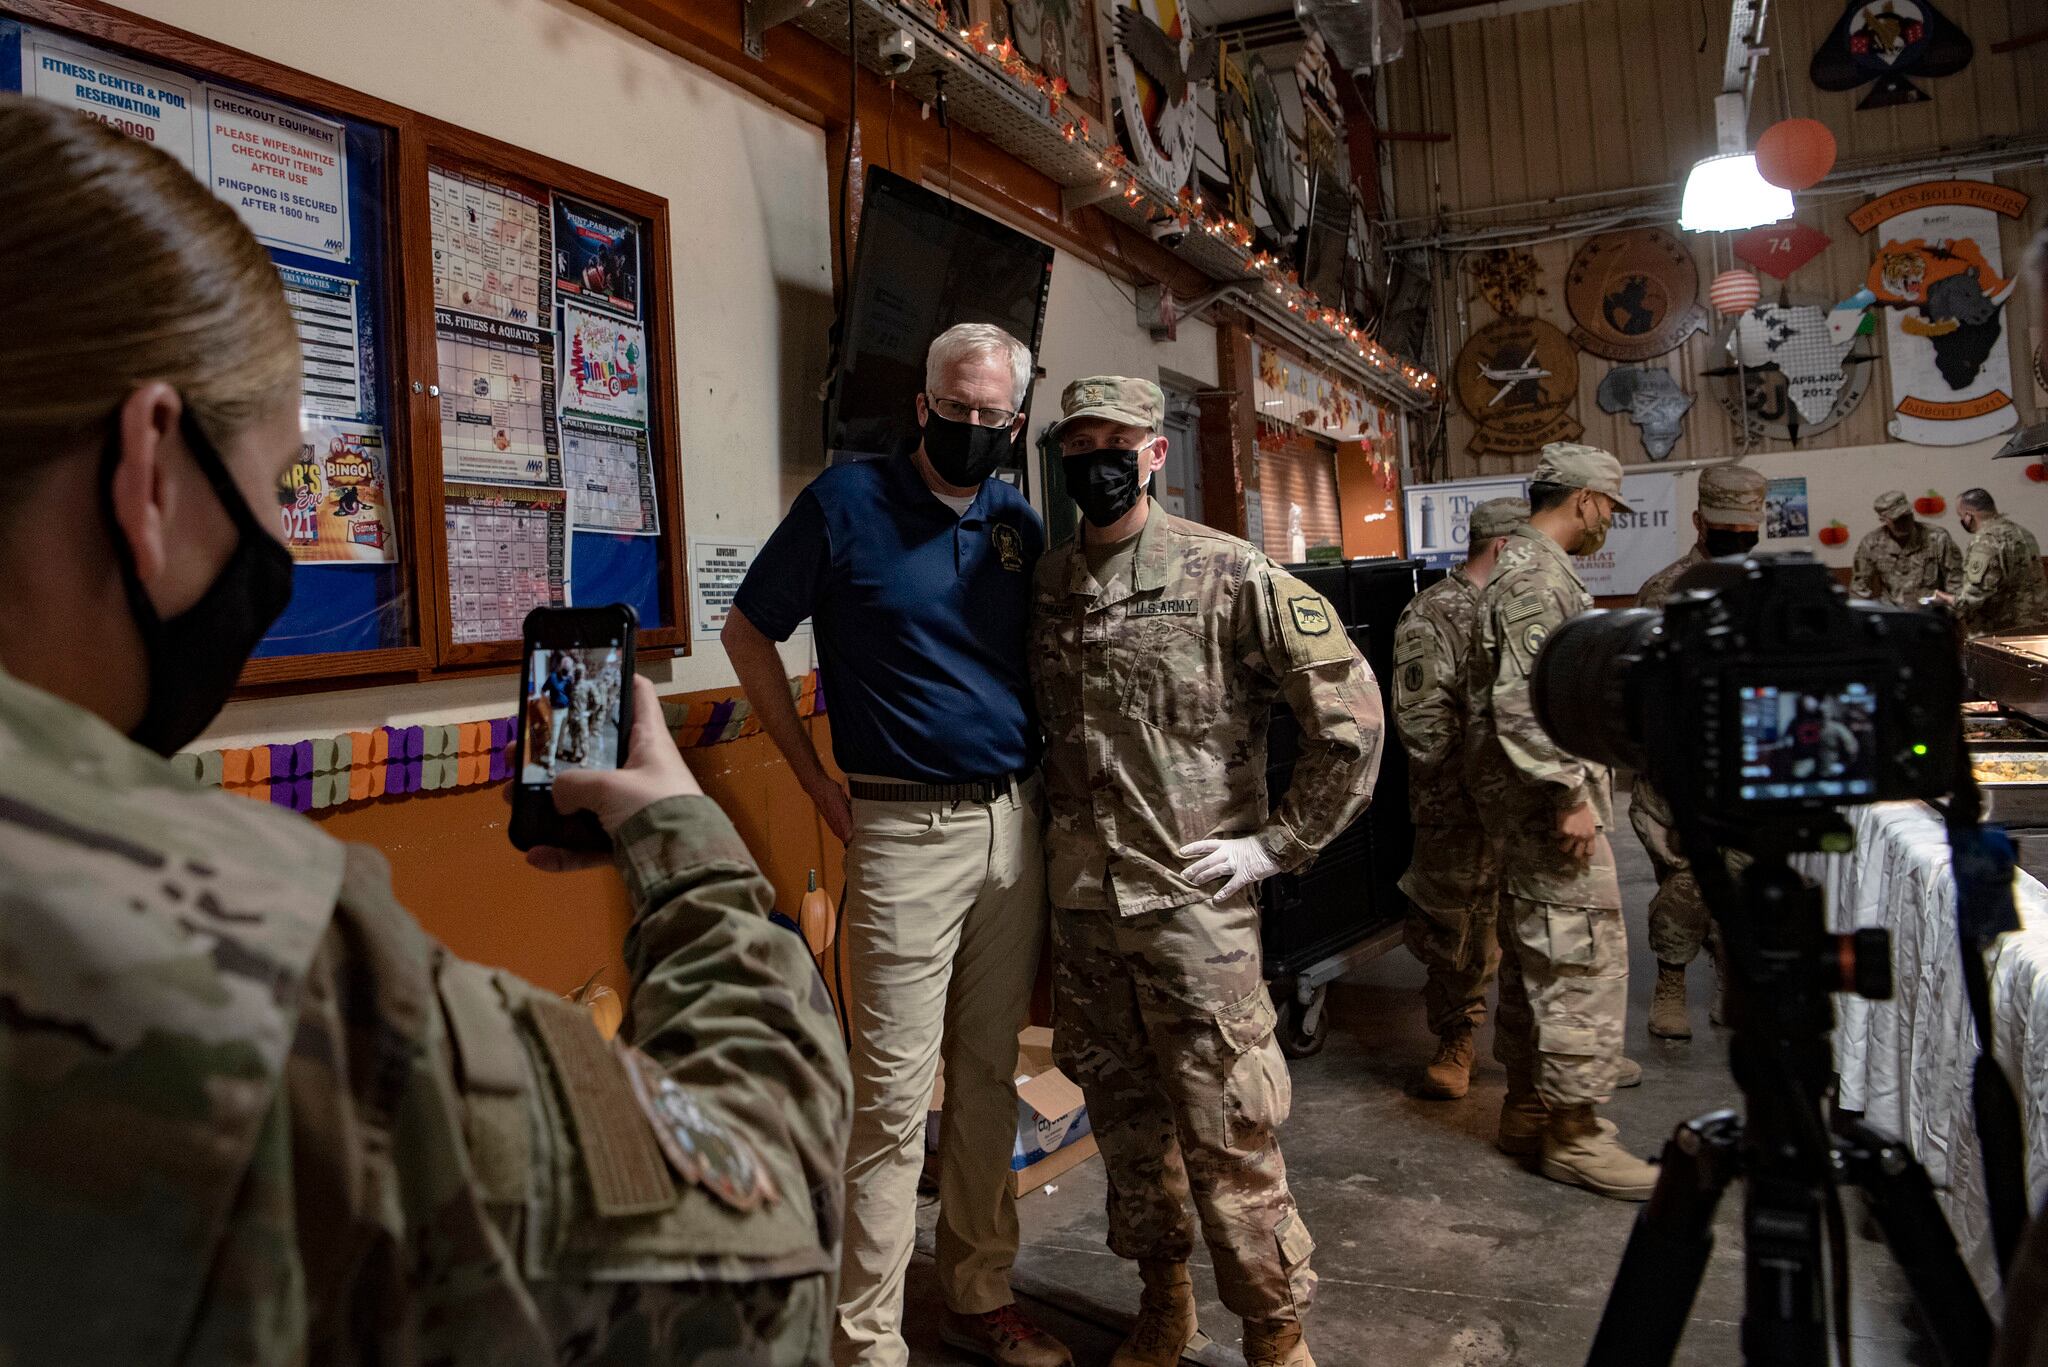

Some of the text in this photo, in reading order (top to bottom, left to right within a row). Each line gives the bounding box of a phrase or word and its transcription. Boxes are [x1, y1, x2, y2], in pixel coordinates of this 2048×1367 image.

[42, 57, 187, 109] FITNESS CENTER & POOL
[76, 84, 161, 119] RESERVATION
[214, 99, 334, 143] CHECKOUT EQUIPMENT
[216, 125, 335, 167] PLEASE WIPE/SANITIZE
[231, 144, 323, 177] CHECKOUT ITEMS
[251, 163, 308, 186] AFTER USE
[218, 176, 337, 215] PINGPONG IS SECURED
[1921, 186, 1962, 201] BOLD
[1967, 186, 2022, 211] TIGERS
[241, 197, 320, 224] AFTER 1800 hrs
[1769, 238, 1792, 253] 74
[303, 275, 330, 289] MOVIES
[455, 316, 489, 333] FITNESS
[489, 324, 496, 333] &
[509, 308, 528, 322] MWR
[1791, 373, 1843, 385] APR-NOV
[1802, 388, 1833, 398] 2012
[1904, 401, 1962, 417] DJIBOUTI
[326, 461, 374, 479] BINGO!
[525, 460, 543, 473] MWR
[295, 484, 324, 510] Eve
[1449, 495, 1480, 514] Th
[280, 507, 317, 540] 021
[354, 523, 378, 533] Games
[1653, 510, 1669, 527] IT
